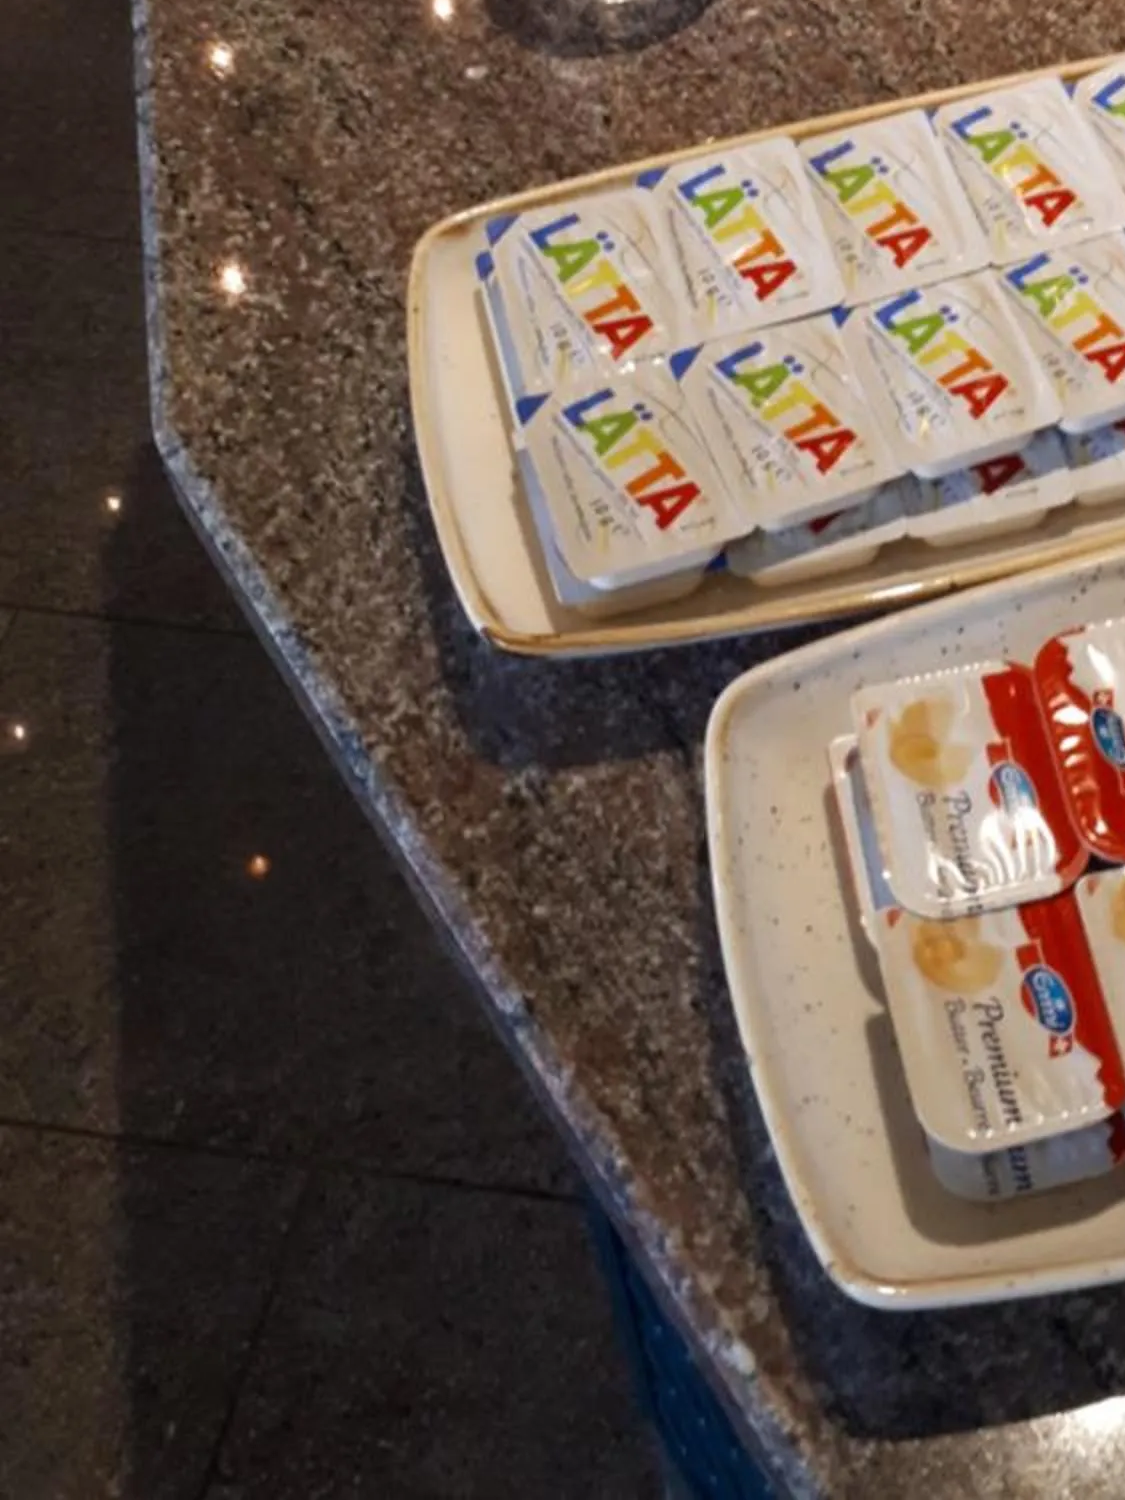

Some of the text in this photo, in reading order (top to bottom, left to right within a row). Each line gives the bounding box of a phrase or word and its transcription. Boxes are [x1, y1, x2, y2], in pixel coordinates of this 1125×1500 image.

[809, 140, 933, 269] LÄTTA
[951, 106, 1077, 228] LÄTTA
[527, 212, 654, 361] LÄTTA
[678, 164, 798, 301] LÄTTA
[715, 341, 857, 475] LÄTTA
[874, 290, 1009, 420] LÄTTA
[561, 388, 701, 530] LÄTTA
[973, 996, 1023, 1125] Premium
[1033, 971, 1065, 1029] Emmi
